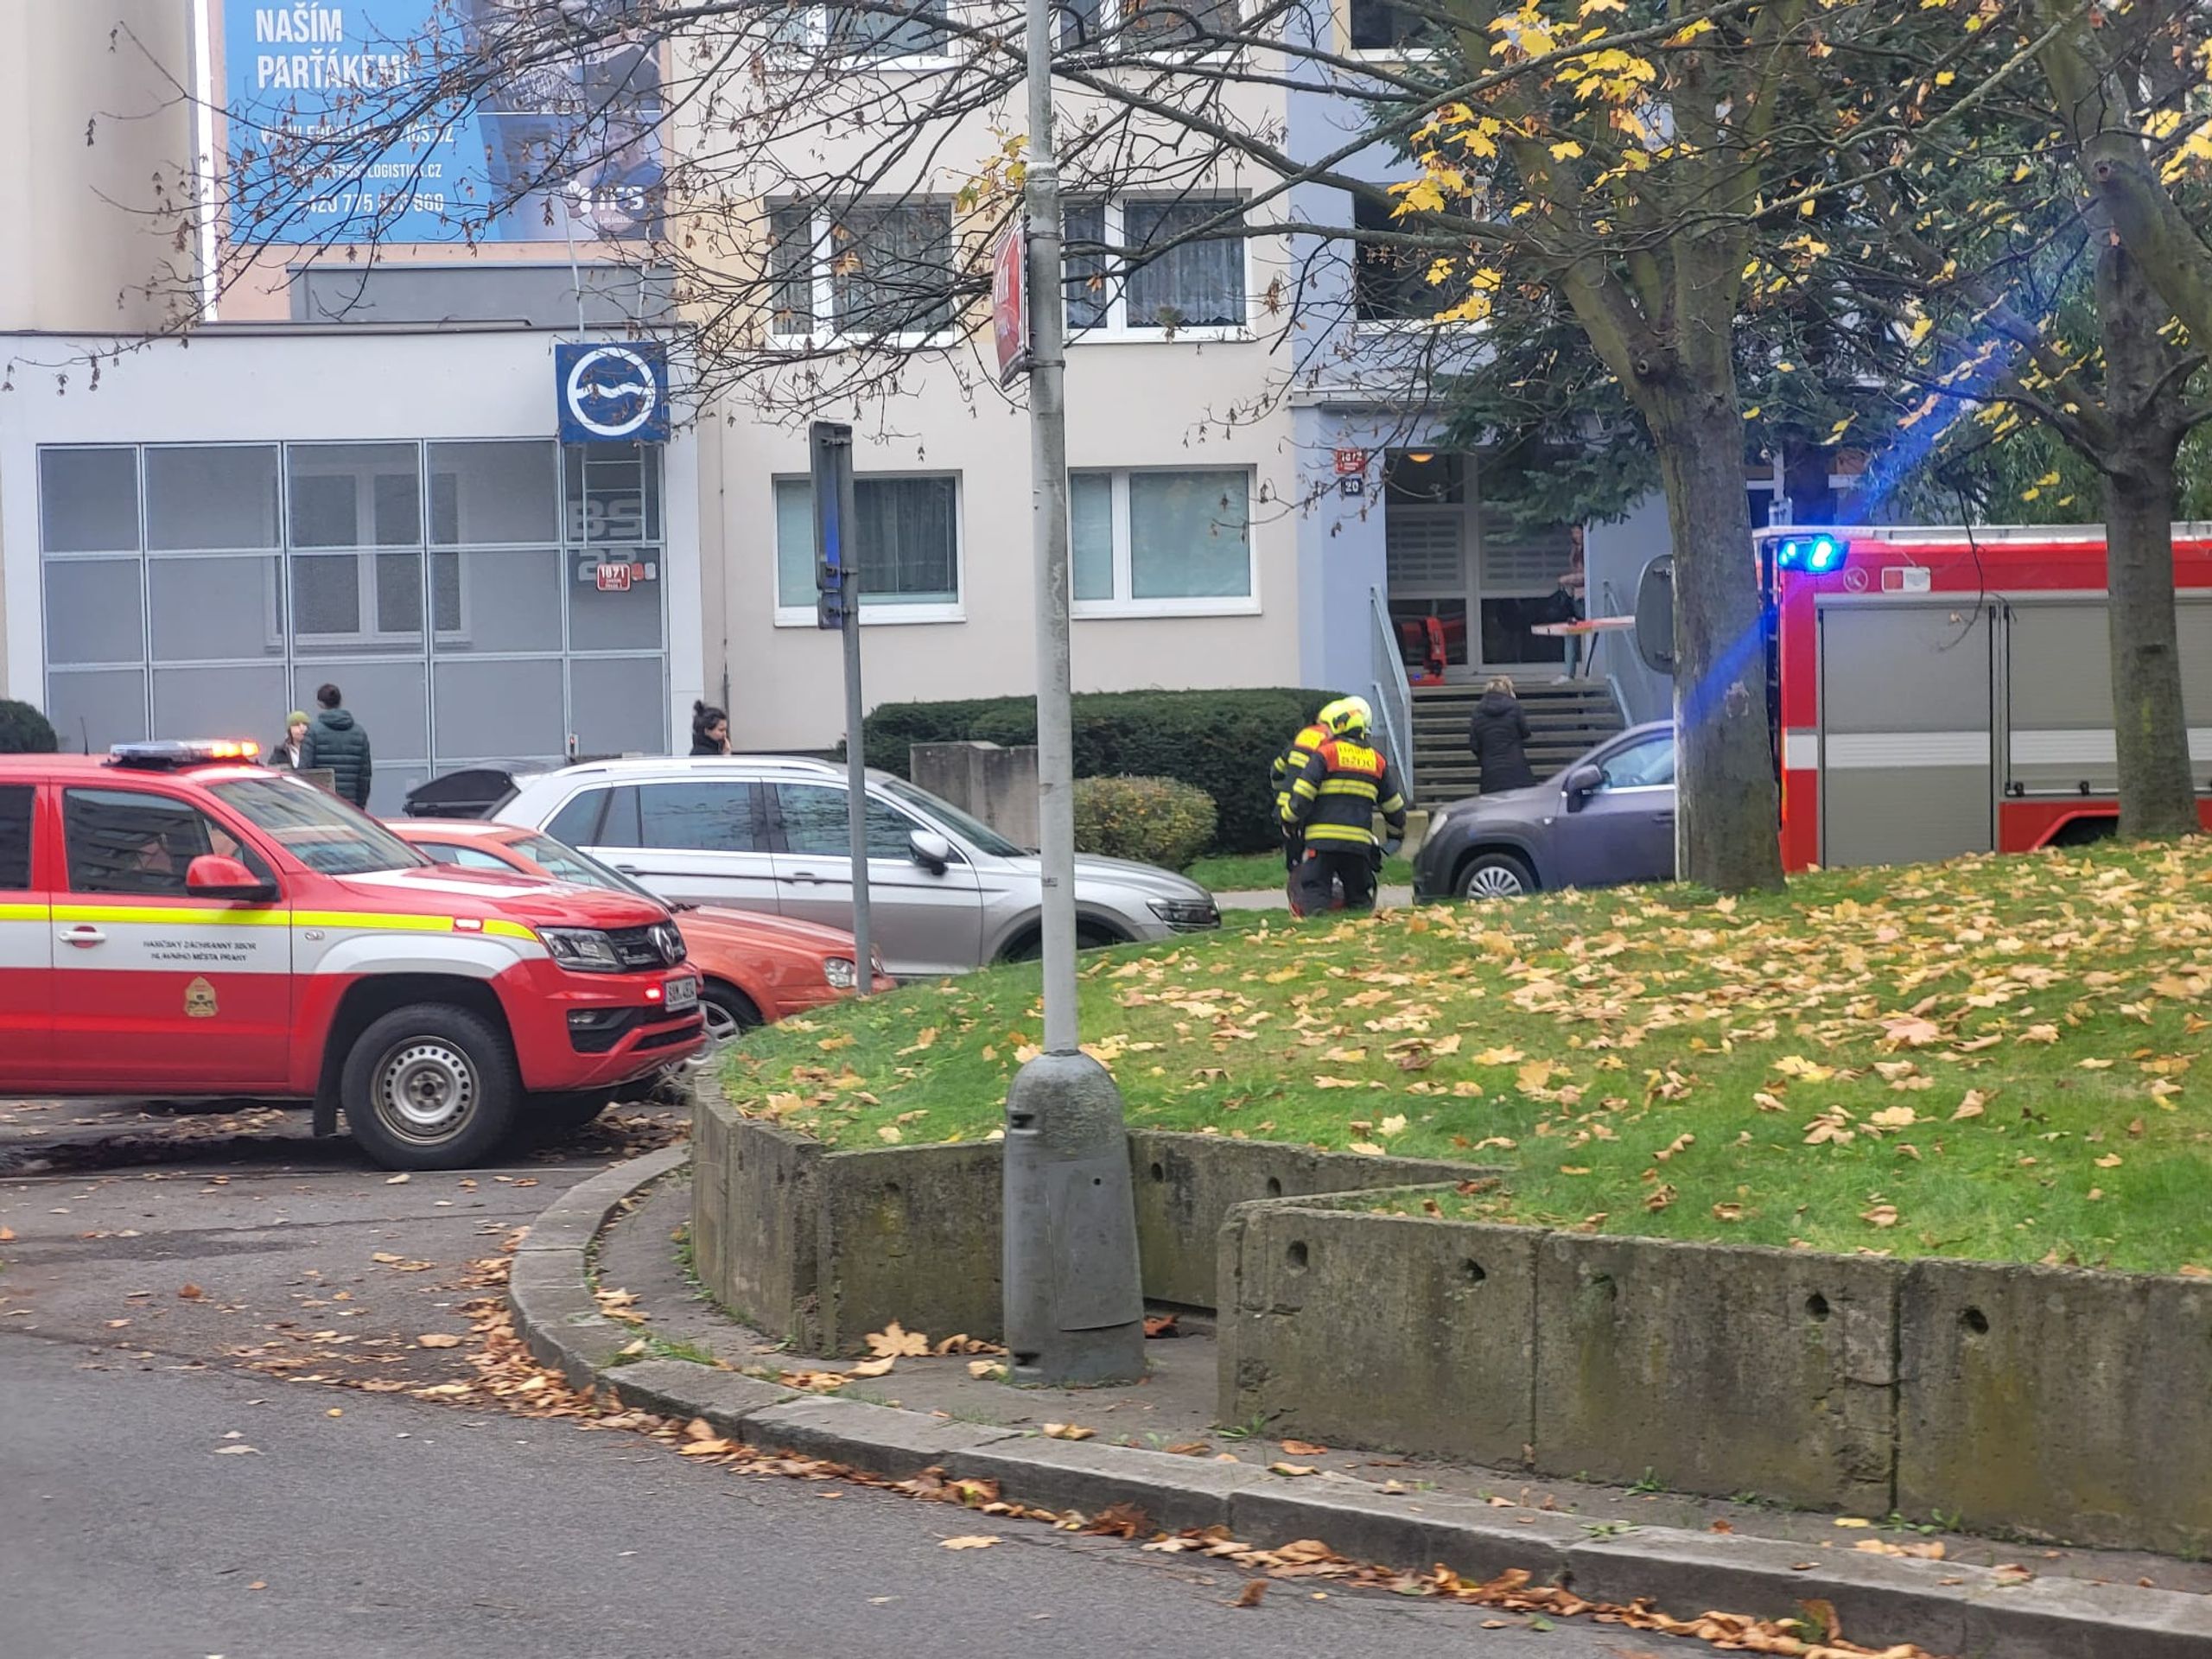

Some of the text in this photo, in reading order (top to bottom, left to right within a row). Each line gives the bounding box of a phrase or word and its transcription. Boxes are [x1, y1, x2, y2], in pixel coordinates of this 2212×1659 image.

[256, 2, 343, 43] NAŠÍM
[343, 193, 373, 213] 775
[1345, 480, 1359, 493] 20
